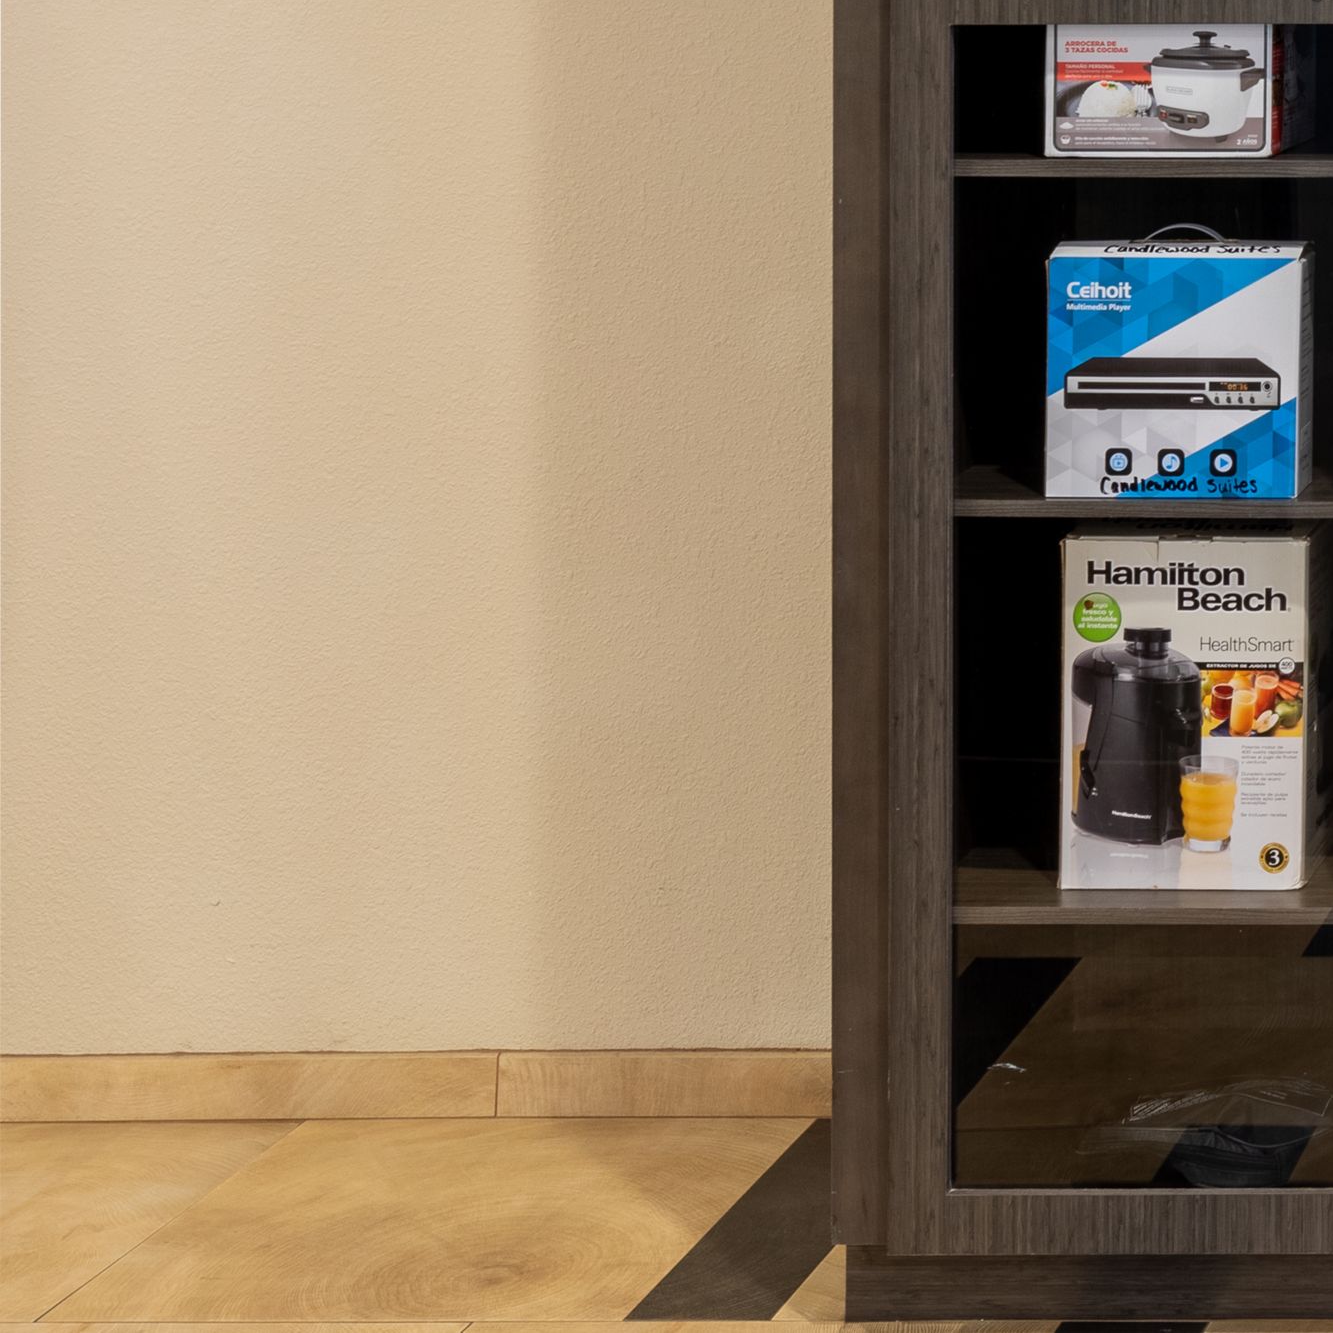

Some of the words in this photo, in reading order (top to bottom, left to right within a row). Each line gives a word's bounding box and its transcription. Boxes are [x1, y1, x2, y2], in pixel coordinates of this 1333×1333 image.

[1103, 243, 1210, 254] Candlewood
[1216, 244, 1281, 254] Suites
[1066, 281, 1132, 299] Ceihoit
[1066, 303, 1107, 311] Multimedia
[1108, 303, 1131, 312] Player
[1100, 477, 1199, 495] Candlewood
[1206, 478, 1258, 494] Suites
[1087, 561, 1245, 587] Hamilton
[1177, 587, 1287, 612] Beach
[1199, 636, 1295, 652] HealthSmart
[1268, 848, 1280, 867] 3
